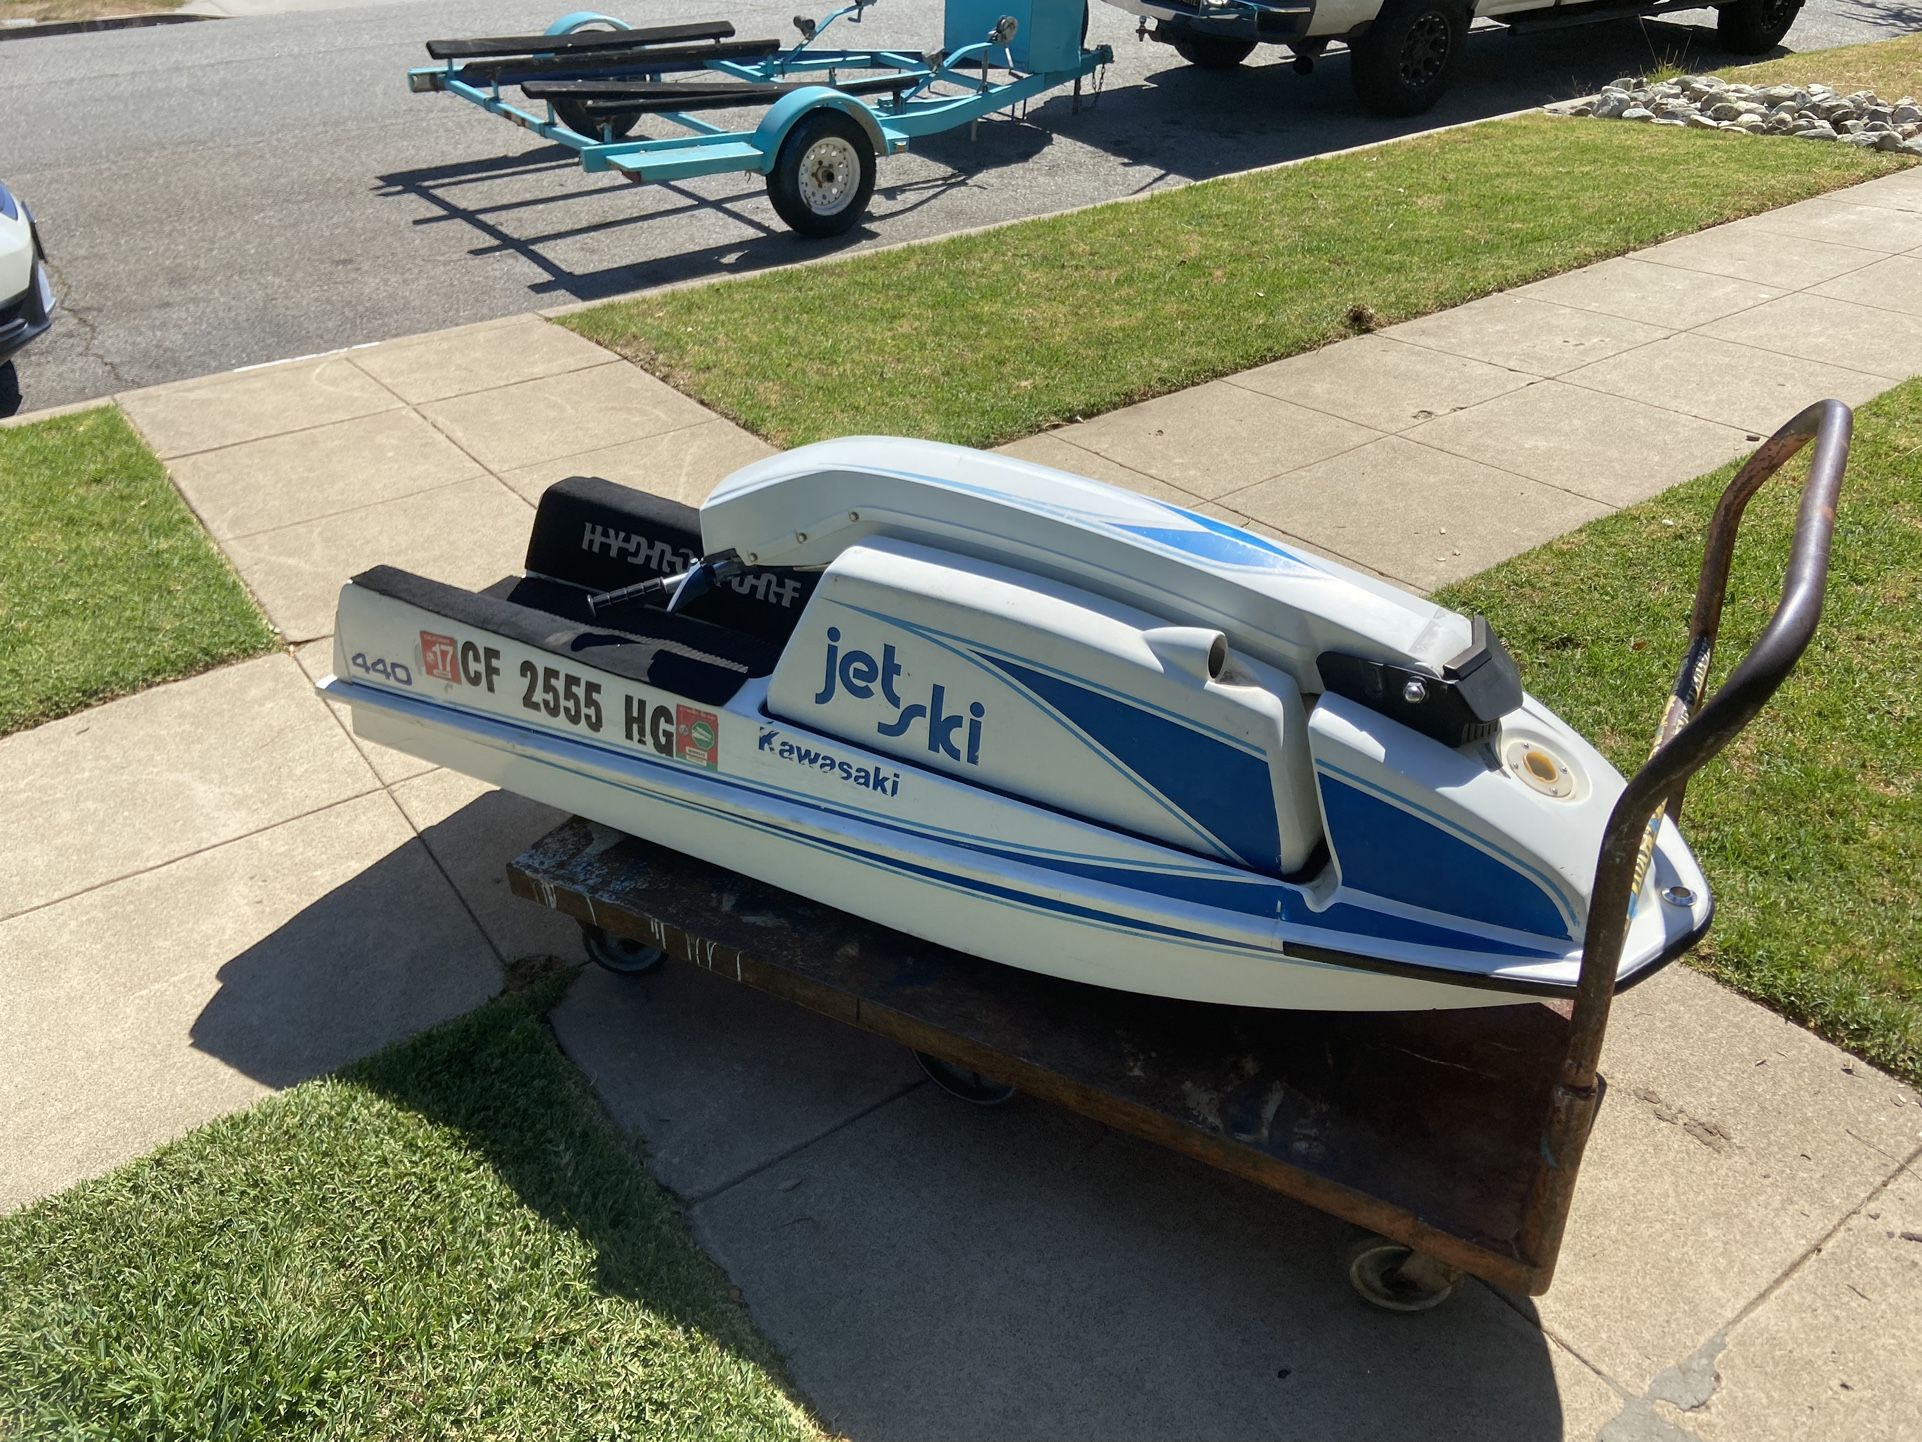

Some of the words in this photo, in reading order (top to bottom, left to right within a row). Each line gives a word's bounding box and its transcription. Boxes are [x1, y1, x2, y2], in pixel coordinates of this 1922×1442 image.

[714, 571, 801, 608] URF
[351, 652, 413, 686] 440
[431, 643, 454, 673] 17
[460, 640, 501, 694] CF
[519, 660, 603, 733] 2555
[624, 693, 675, 758] HG
[814, 626, 902, 710] jet
[877, 683, 985, 766] ski
[758, 721, 900, 798] Kawasaki
